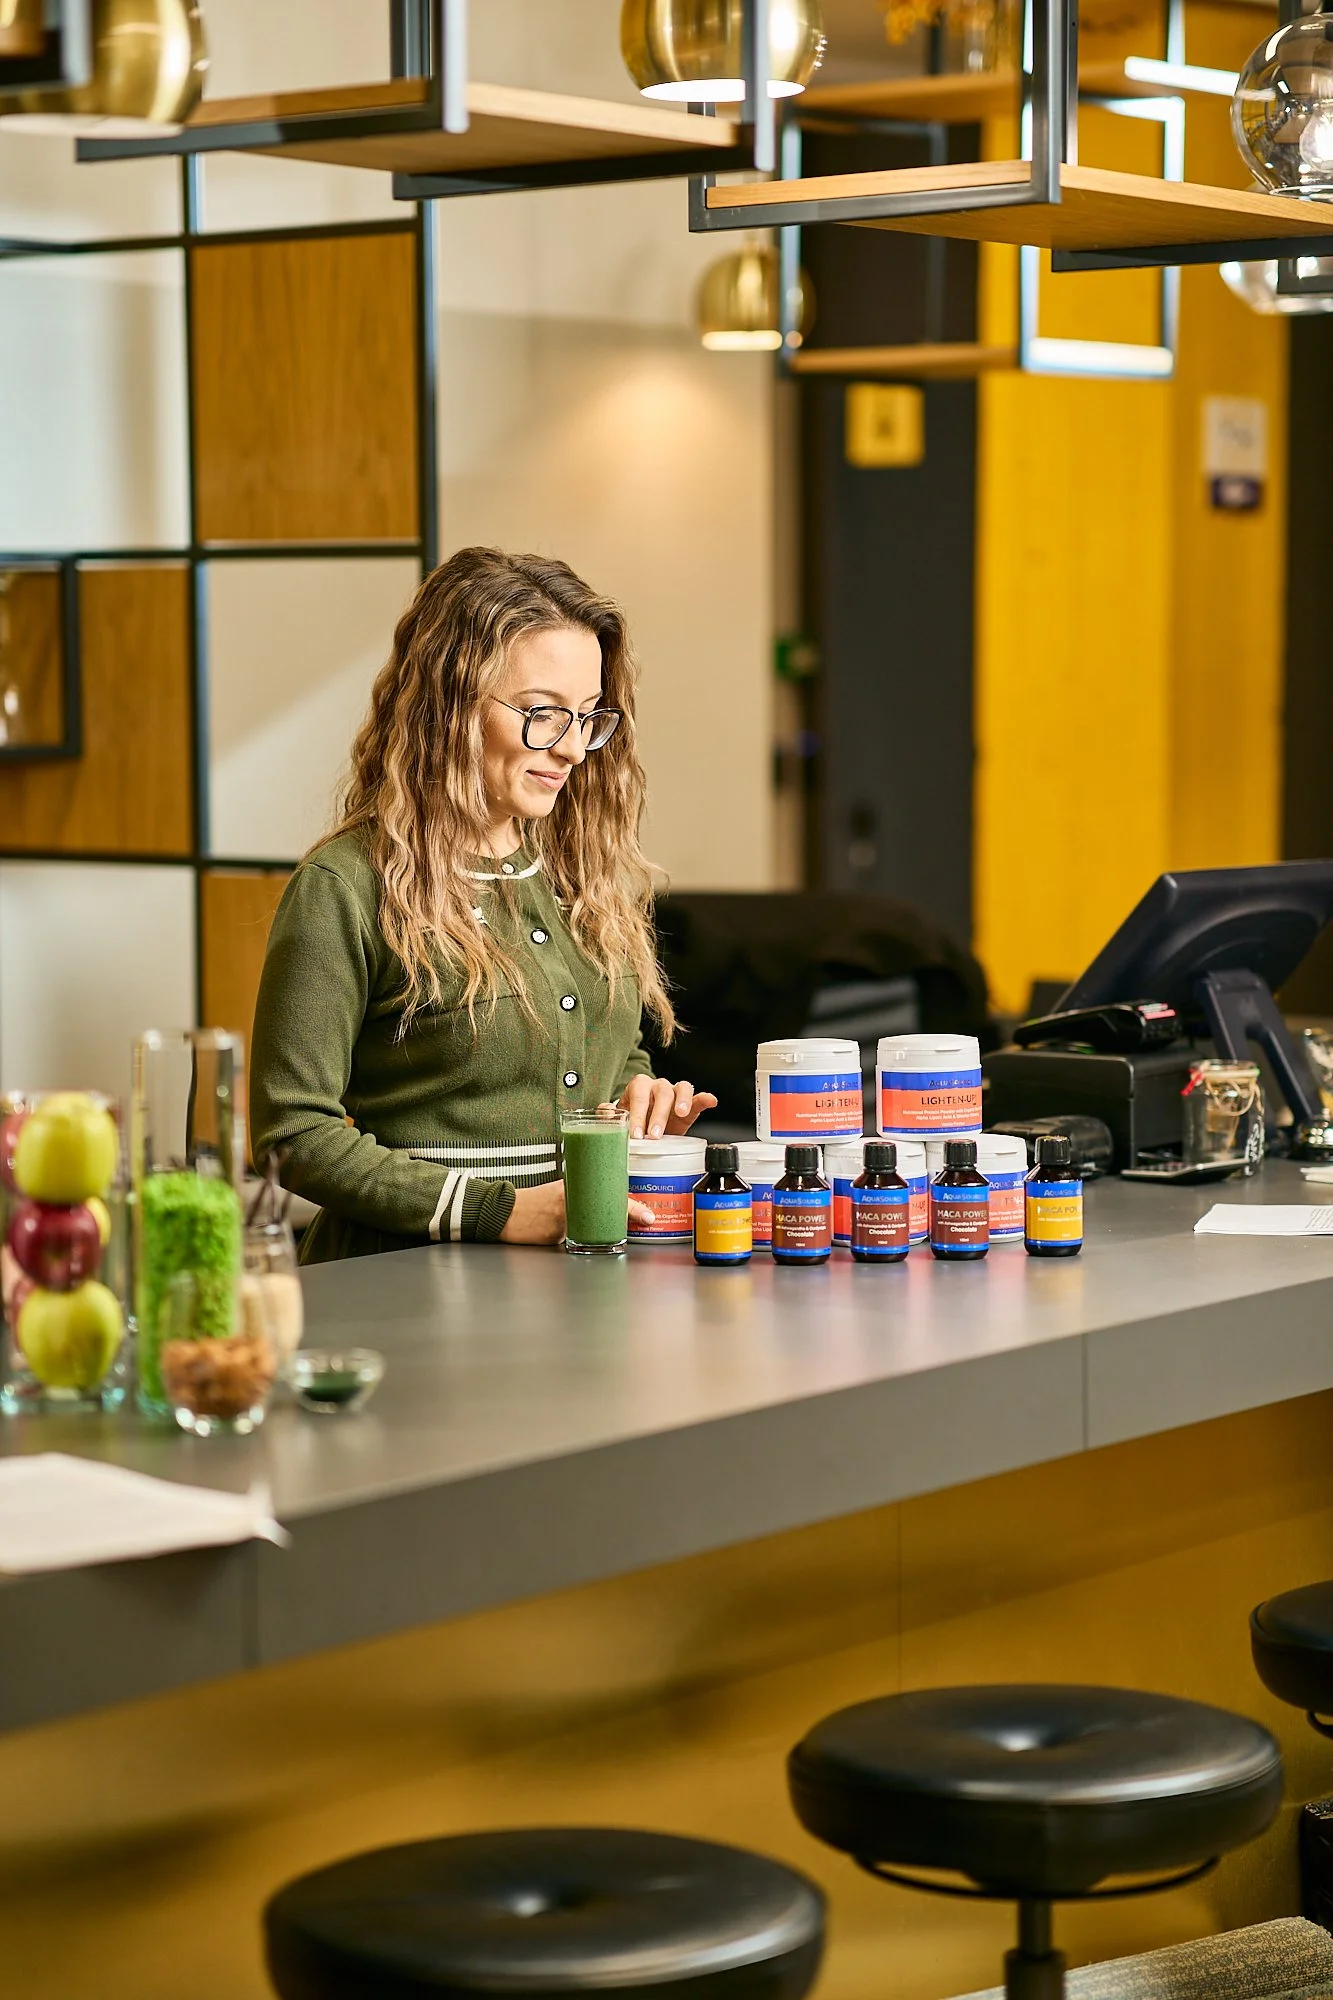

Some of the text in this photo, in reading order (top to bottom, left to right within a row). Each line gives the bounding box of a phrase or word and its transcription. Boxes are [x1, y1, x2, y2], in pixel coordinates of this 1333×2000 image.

[775, 1213, 797, 1223] MACA
[856, 1211, 880, 1221] MACA
[937, 1209, 961, 1218] MACA
